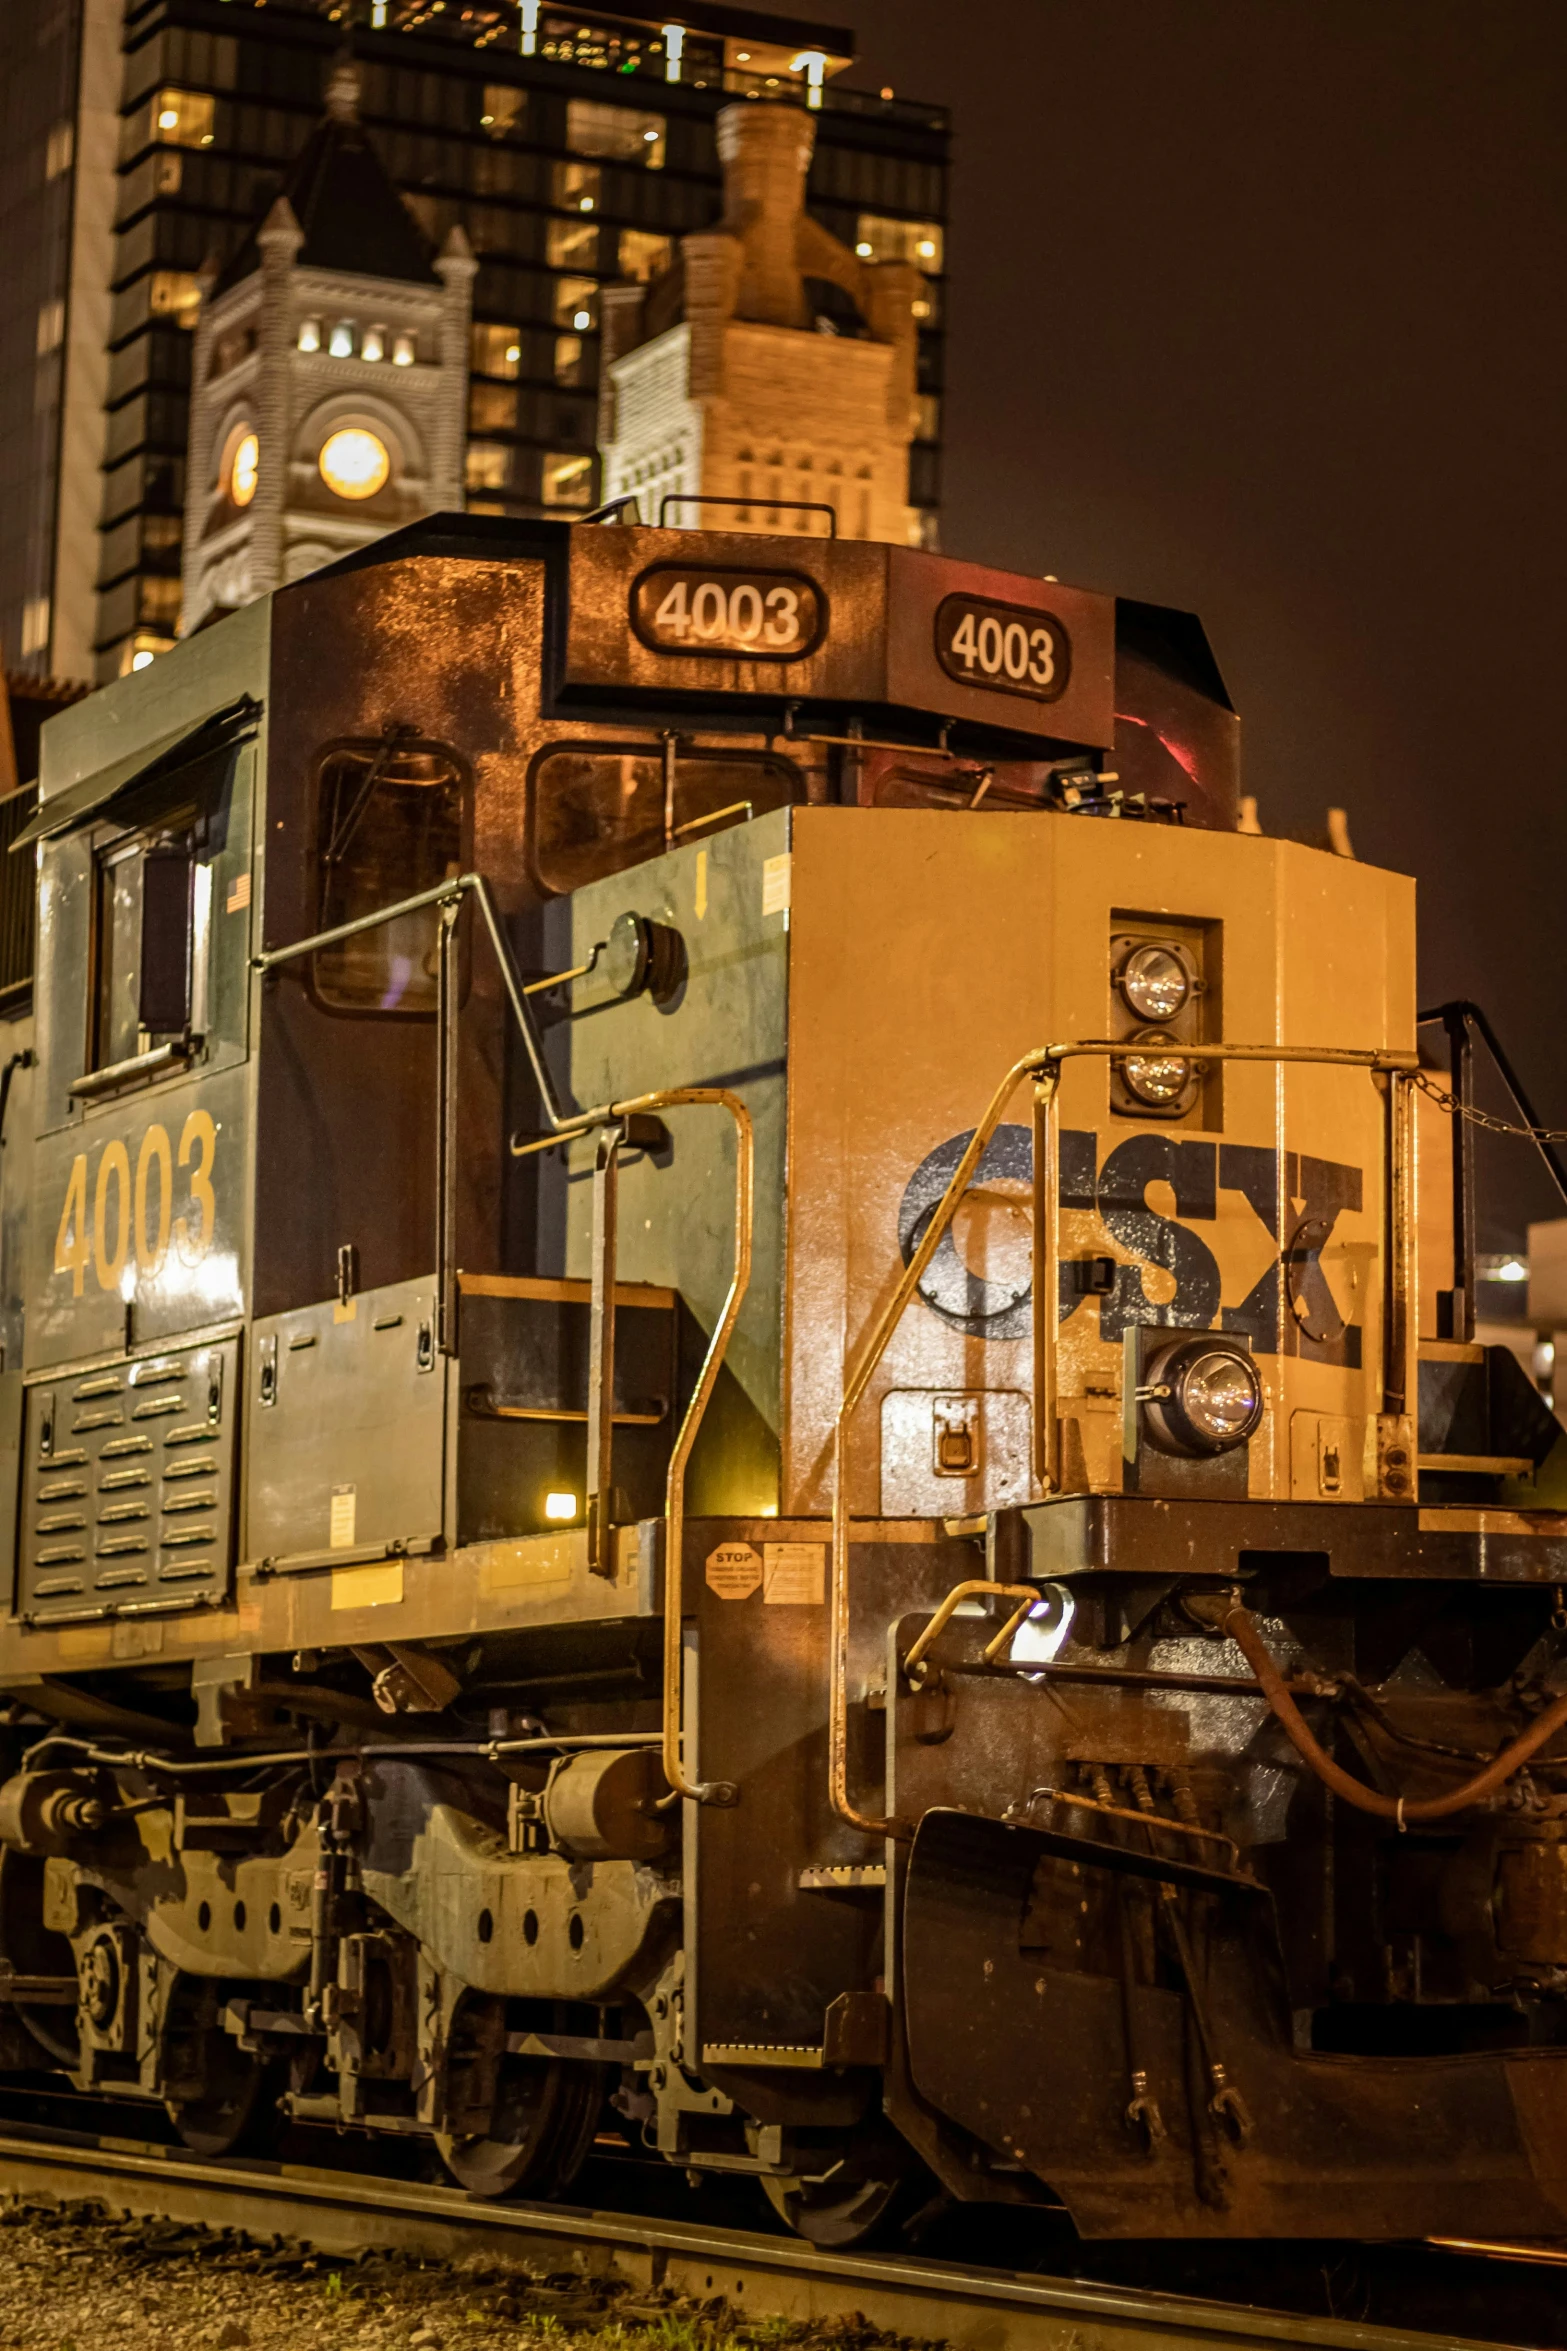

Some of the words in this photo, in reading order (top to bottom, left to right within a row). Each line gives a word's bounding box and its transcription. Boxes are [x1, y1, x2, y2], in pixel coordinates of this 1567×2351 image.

[656, 582, 799, 645] 4003
[951, 613, 1055, 685] 4003
[54, 1109, 216, 1297] 4003
[898, 1123, 1363, 1369] CSX
[626, 1552, 638, 1586] F
[716, 1552, 753, 1562] STOP
